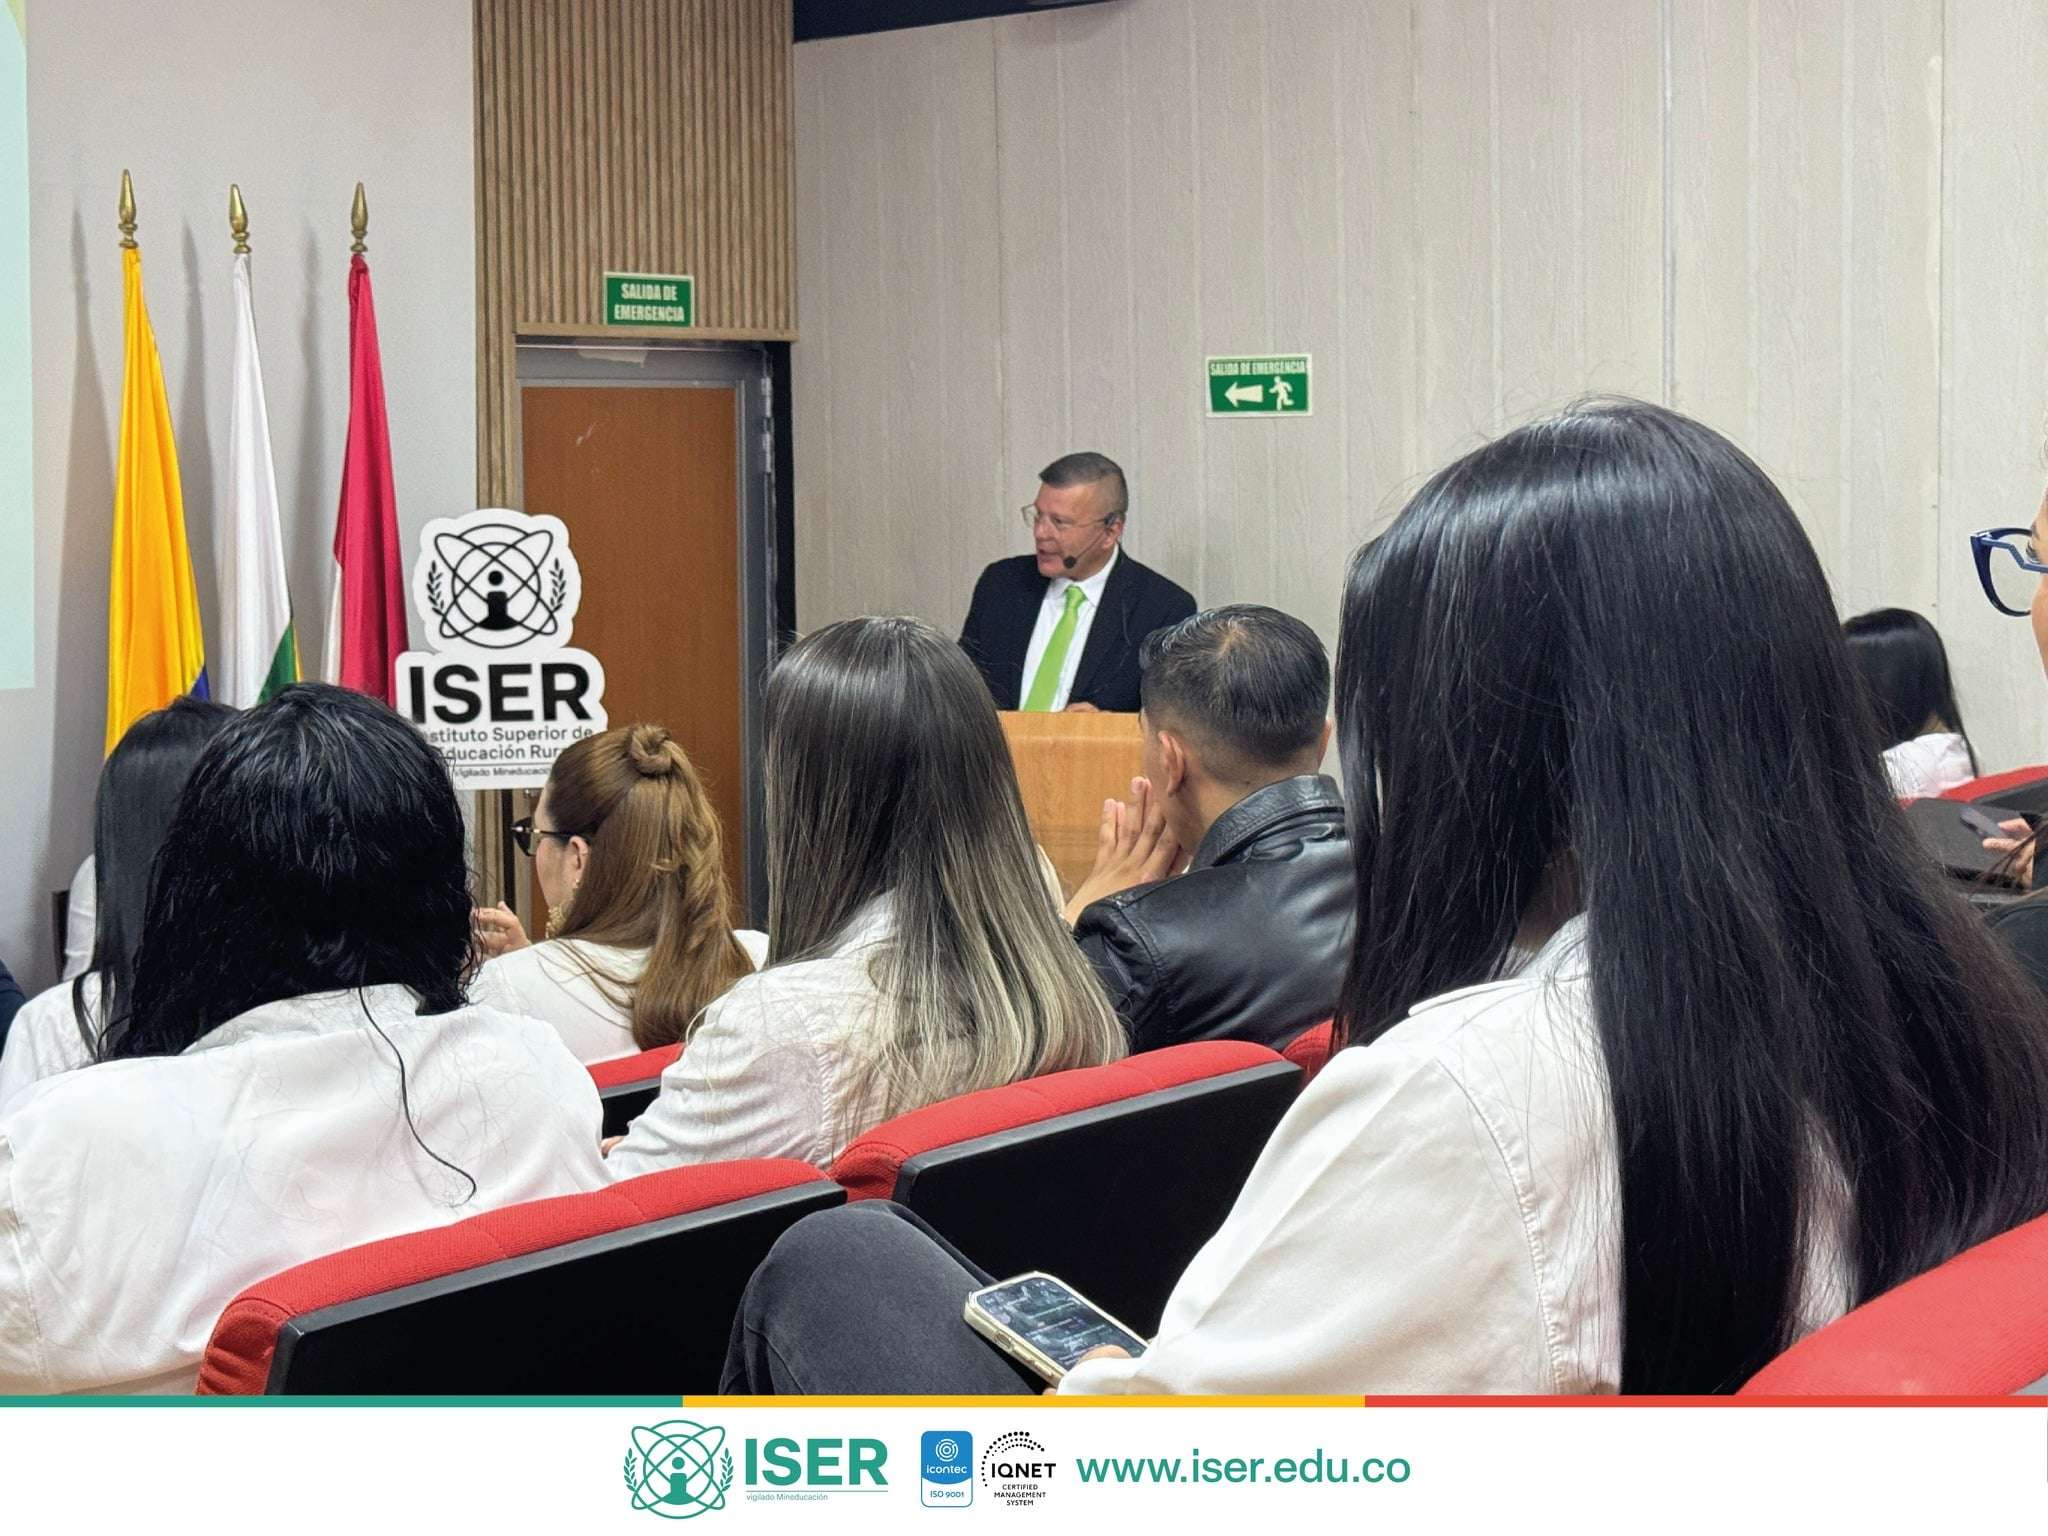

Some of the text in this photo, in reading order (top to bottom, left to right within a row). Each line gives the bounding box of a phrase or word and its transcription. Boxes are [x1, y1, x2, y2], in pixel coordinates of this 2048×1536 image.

[621, 283, 678, 301] SALIDA DE
[614, 304, 685, 322] EMERGENCIA
[409, 662, 592, 724] ISER
[424, 725, 593, 744] stituto Superior de
[530, 744, 562, 759] Rur
